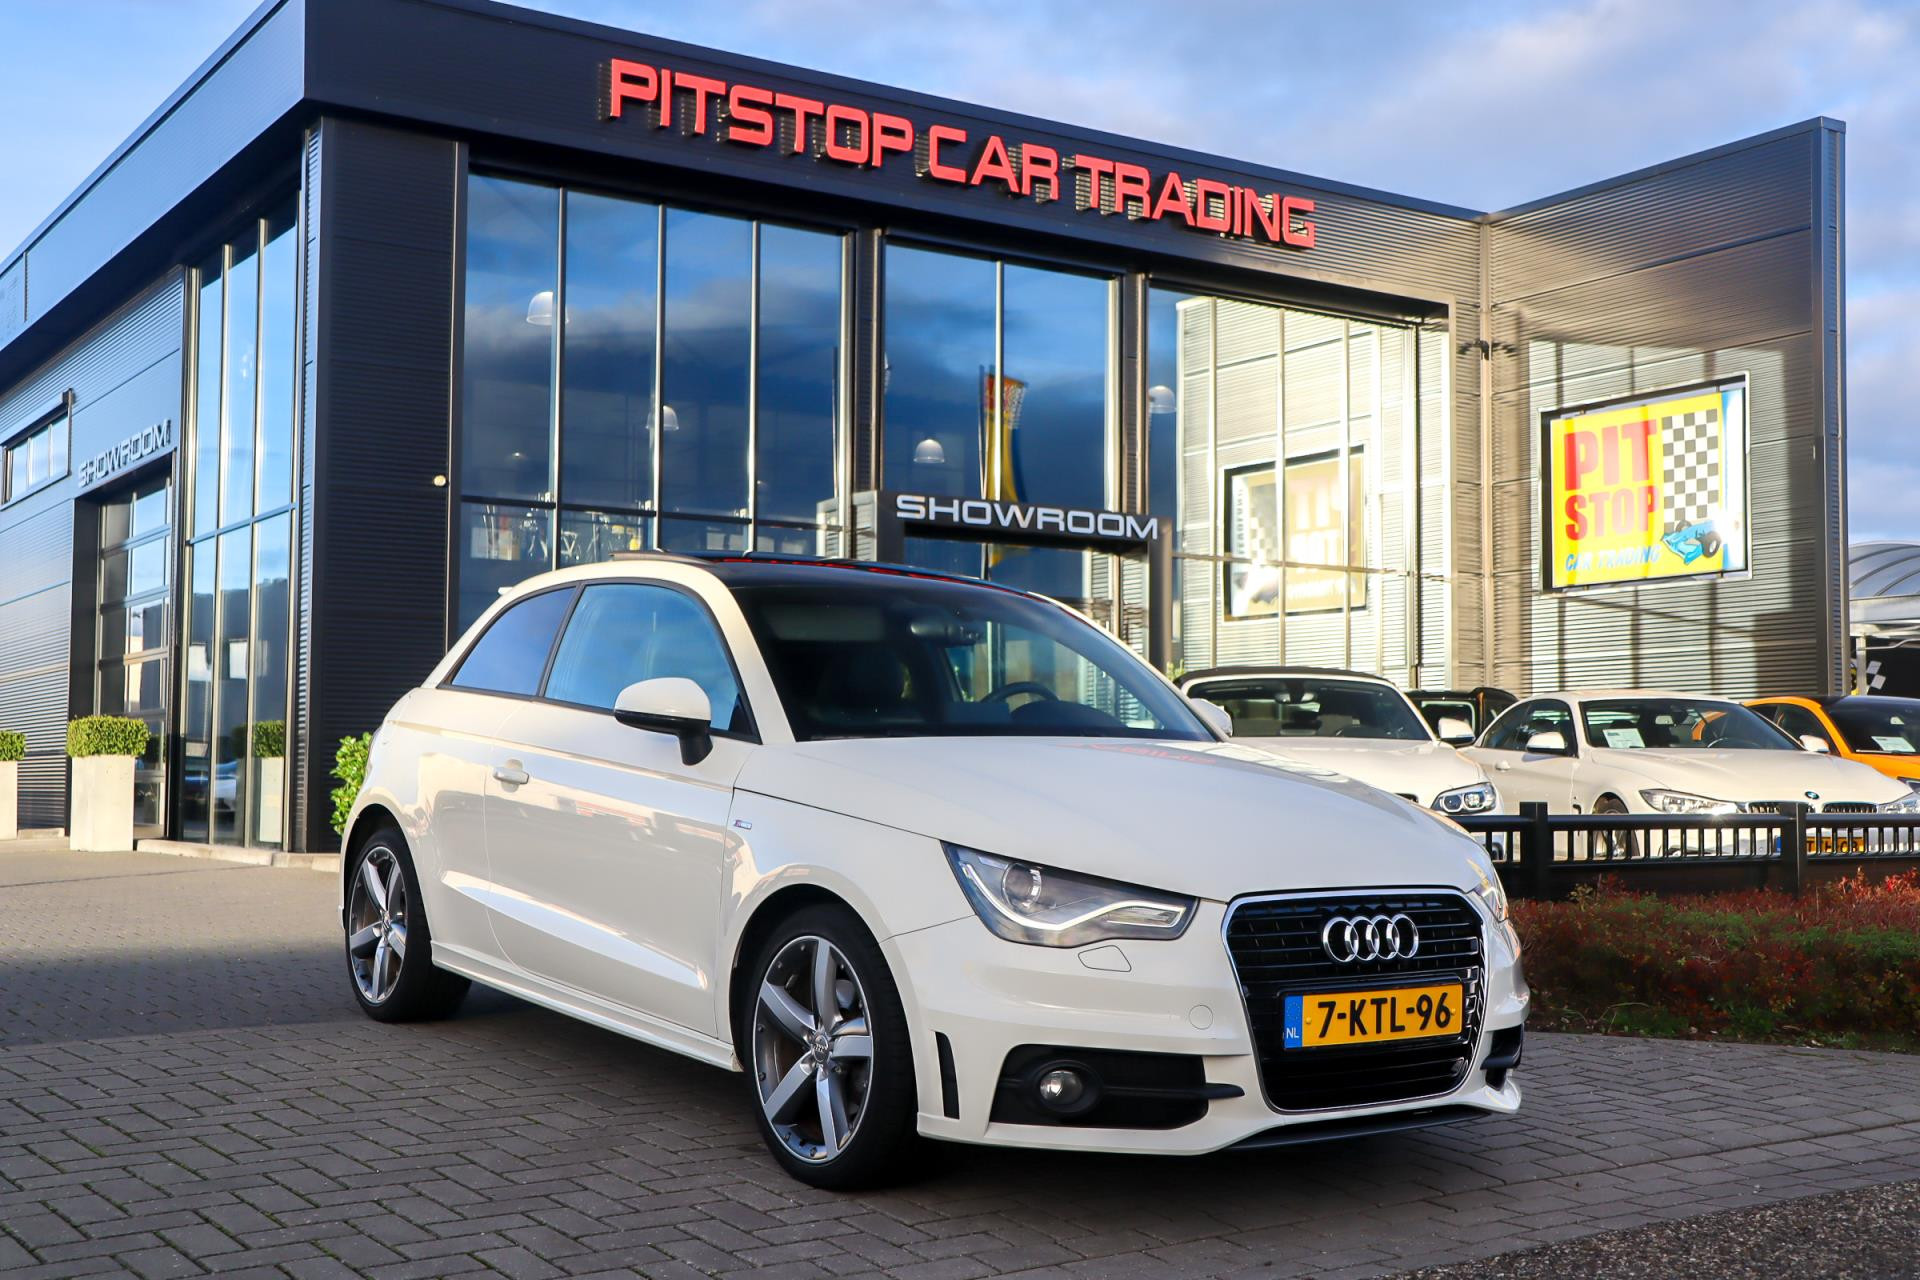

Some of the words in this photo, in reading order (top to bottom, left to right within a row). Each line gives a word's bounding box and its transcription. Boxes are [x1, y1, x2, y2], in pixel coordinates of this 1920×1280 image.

[610, 58, 913, 168] PITSTOP
[929, 124, 1059, 201] CAR
[1075, 154, 1315, 249] TRADING
[78, 418, 171, 488] SHOWROOM
[1565, 420, 1657, 490] PIT
[896, 494, 1158, 540] SHOWROOM
[1565, 486, 1659, 540] STOP
[1566, 552, 1593, 571] CAR
[1599, 545, 1661, 568] TRADING
[1286, 1027, 1300, 1039] NL
[1317, 992, 1451, 1039] 7-KTL-96
